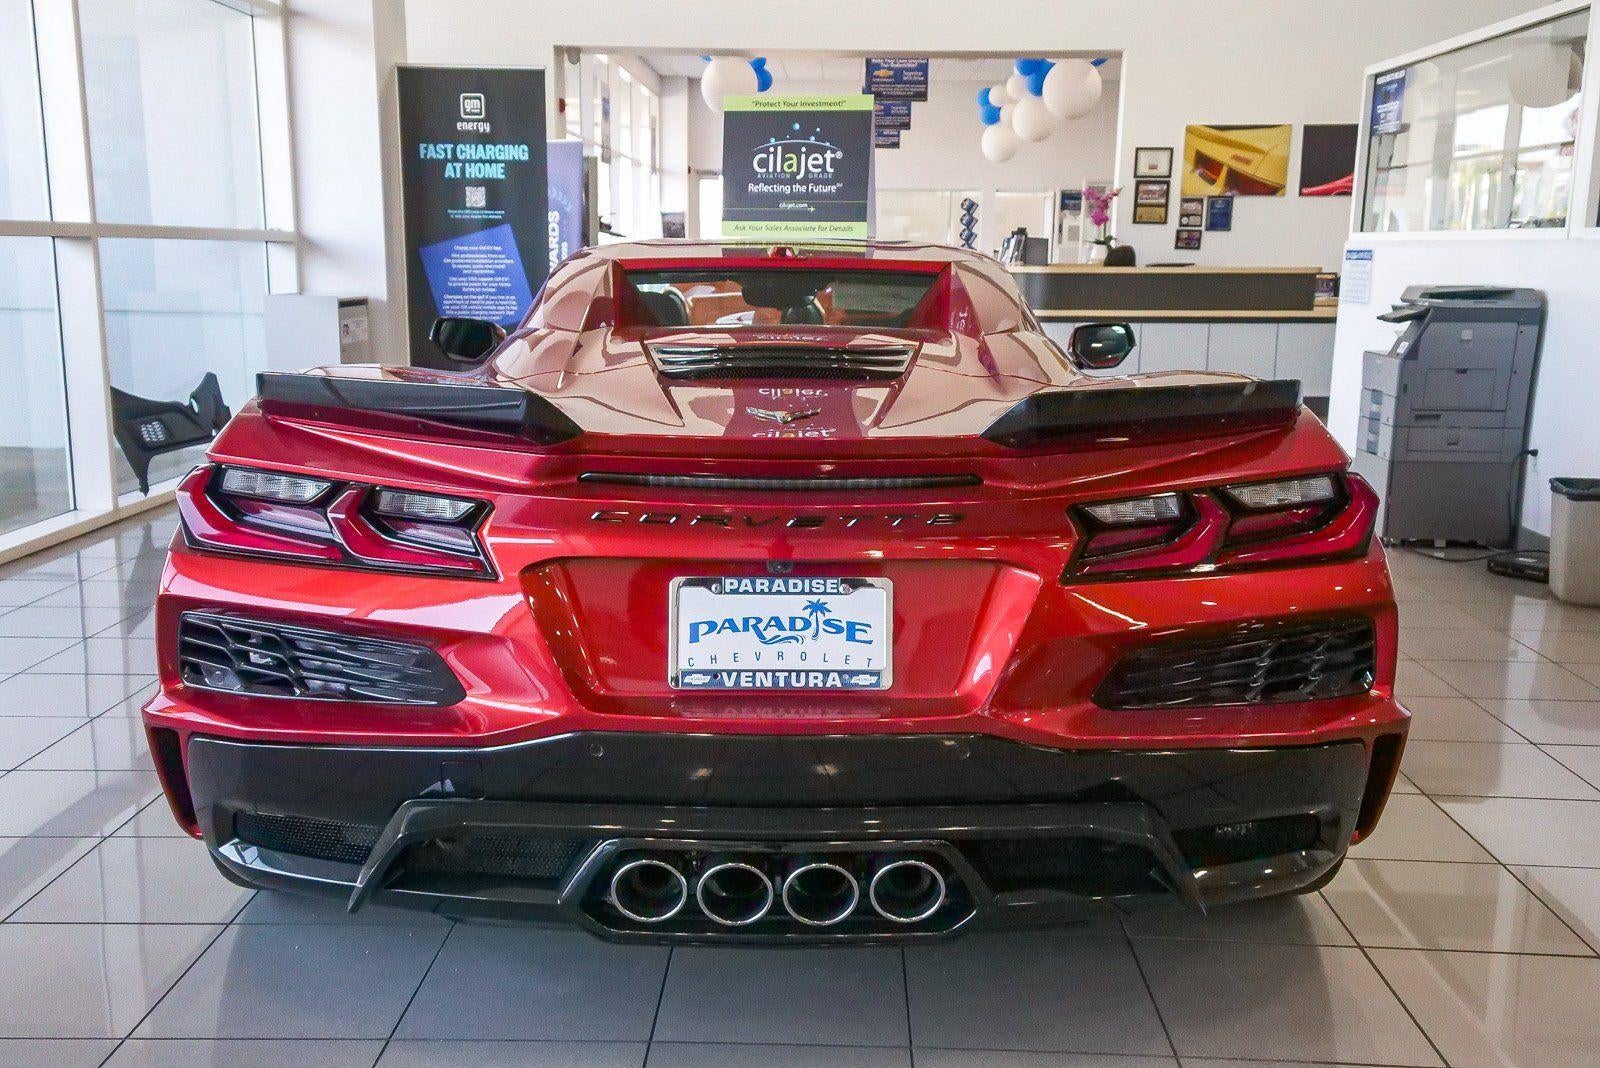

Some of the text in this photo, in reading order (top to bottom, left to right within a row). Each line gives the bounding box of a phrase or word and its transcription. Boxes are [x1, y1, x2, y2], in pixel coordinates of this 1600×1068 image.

[464, 99, 481, 112] gm
[456, 121, 490, 133] energy
[419, 143, 530, 161] FAST CHARGING
[444, 162, 506, 179] AT HOME
[748, 182, 791, 194] Reflecting
[792, 182, 807, 192] the
[828, 224, 854, 232] Details
[590, 511, 965, 528] CORVETTE
[725, 579, 840, 594] PARADISE
[688, 600, 874, 645] PARADISE
[688, 651, 873, 668] CHEVROLET
[725, 671, 842, 688] VENTURA
